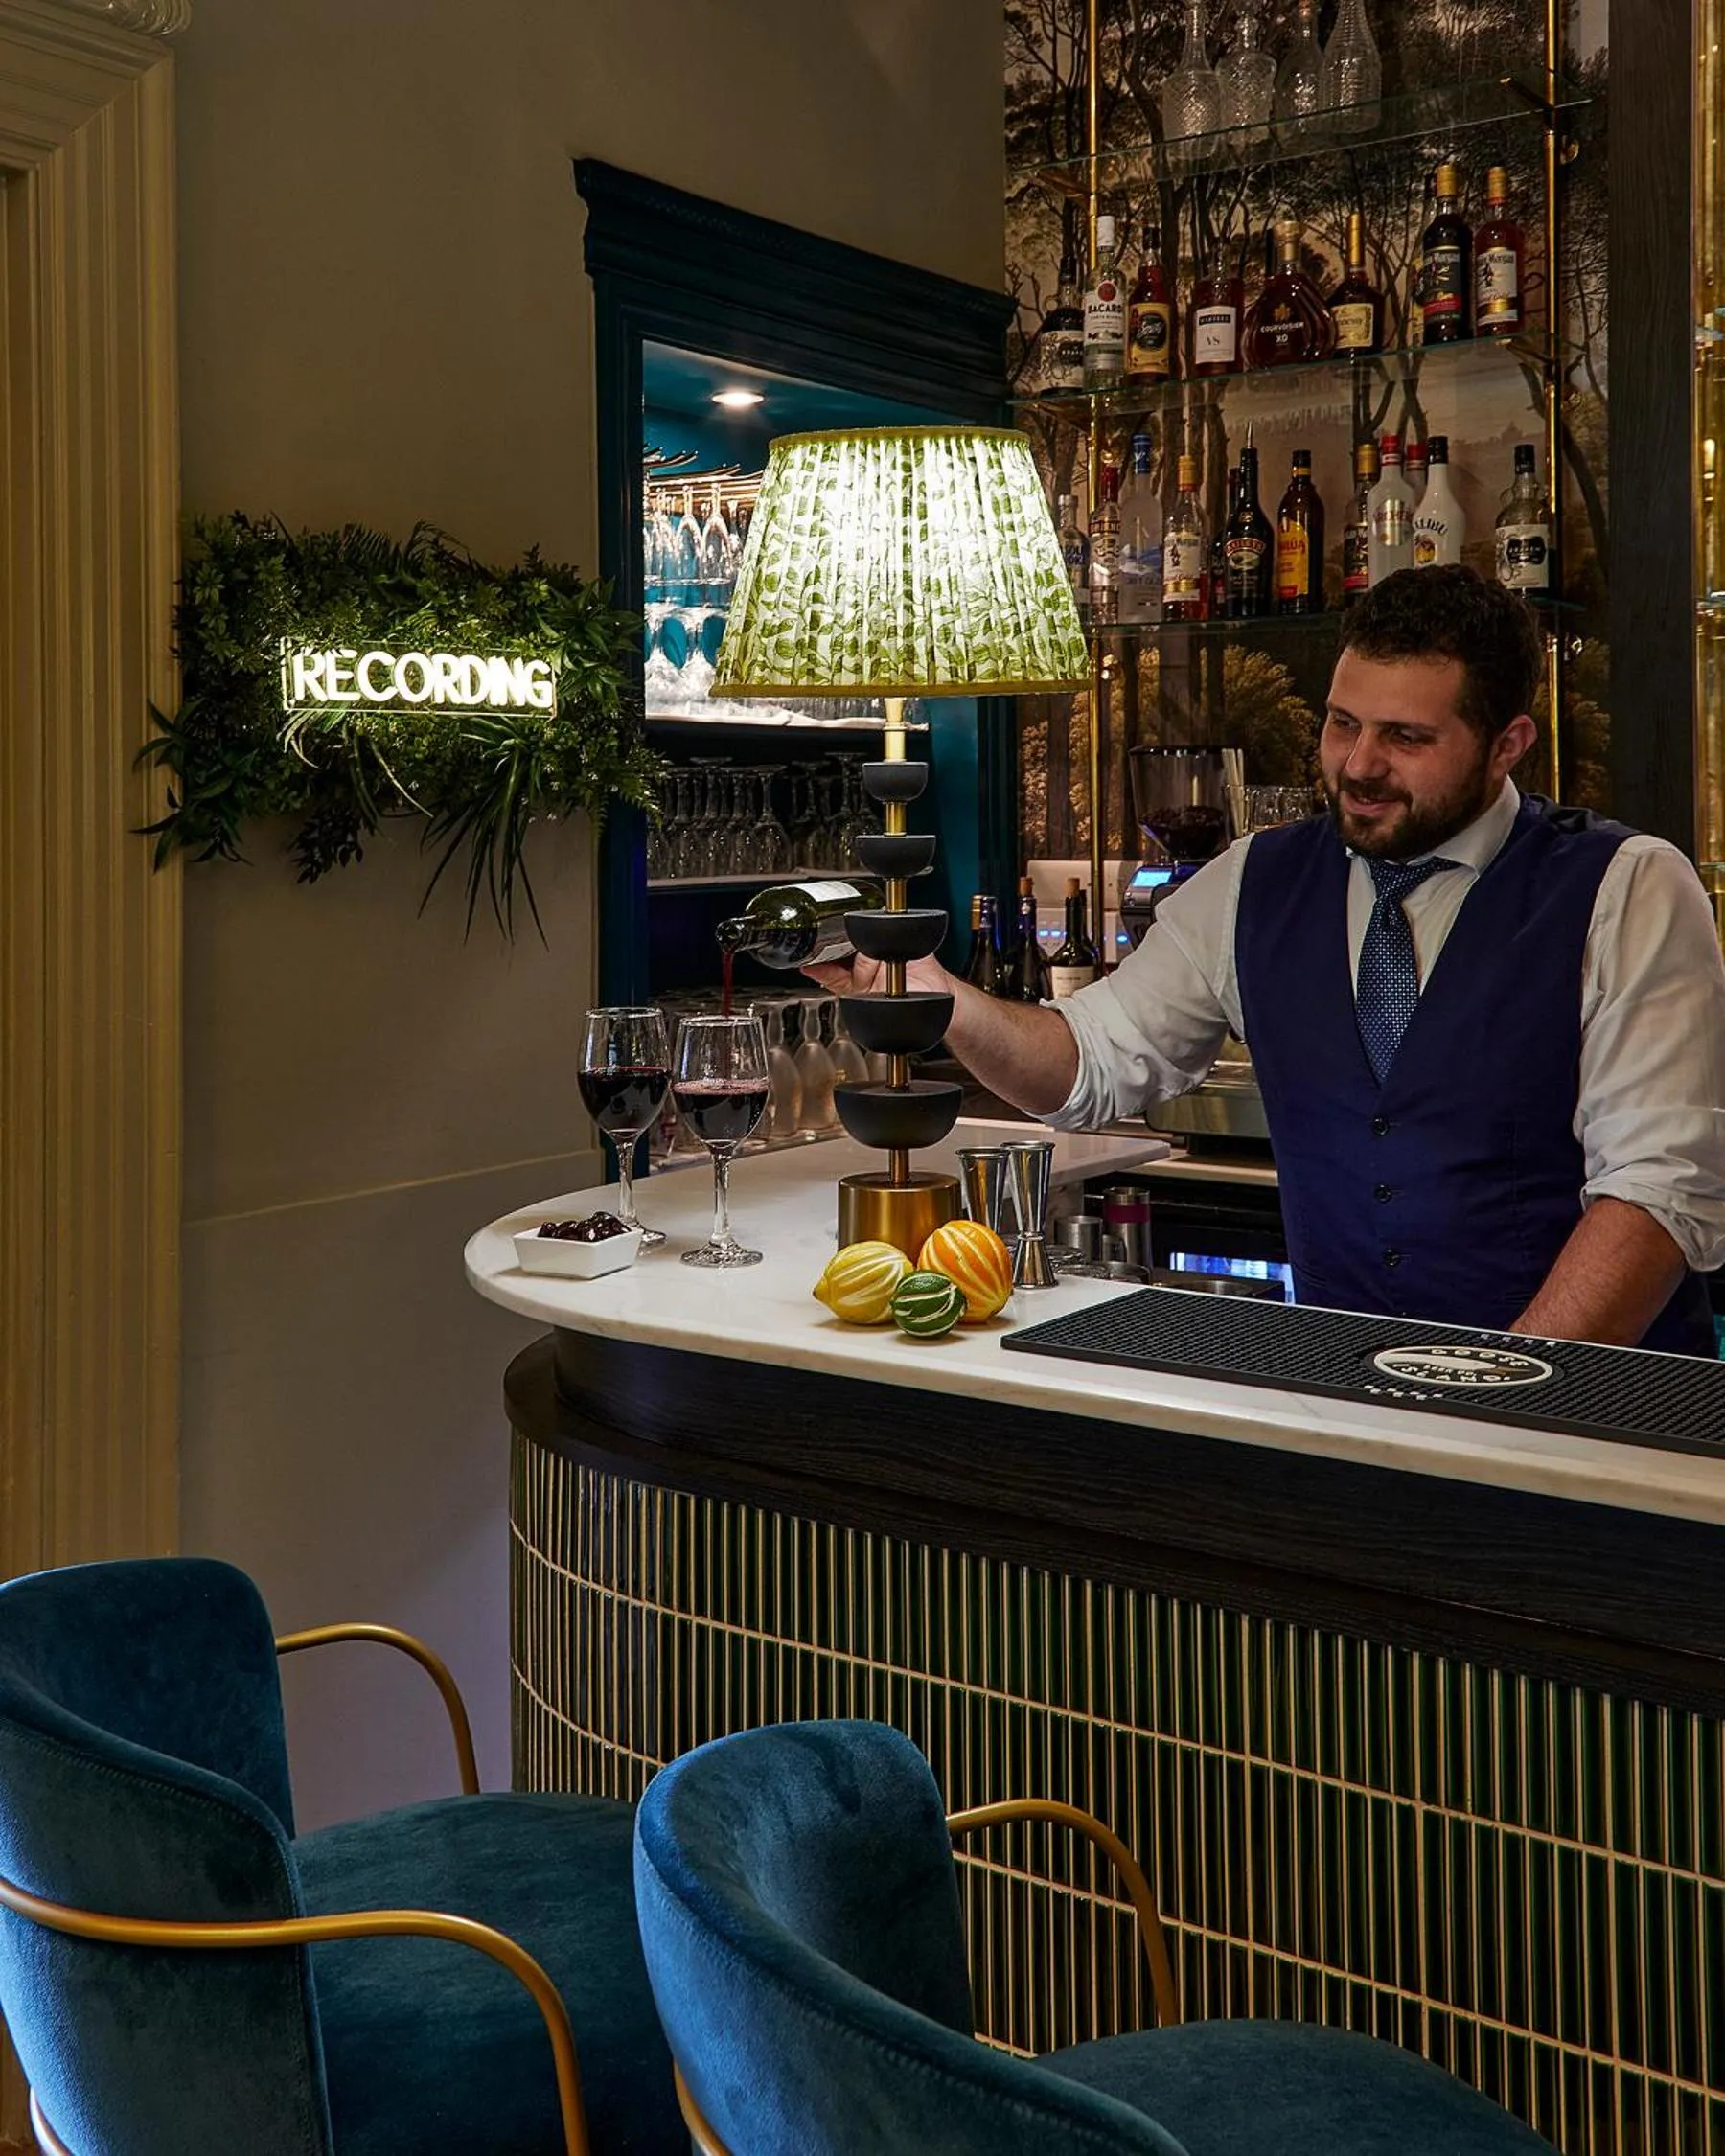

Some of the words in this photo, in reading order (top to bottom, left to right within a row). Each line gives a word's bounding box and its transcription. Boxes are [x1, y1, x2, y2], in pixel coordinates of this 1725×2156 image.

[1276, 333, 1288, 342] XO
[1414, 518, 1448, 536] LIBU
[292, 646, 554, 707] RECORDING
[1431, 1348, 1530, 1366] GOOSE
